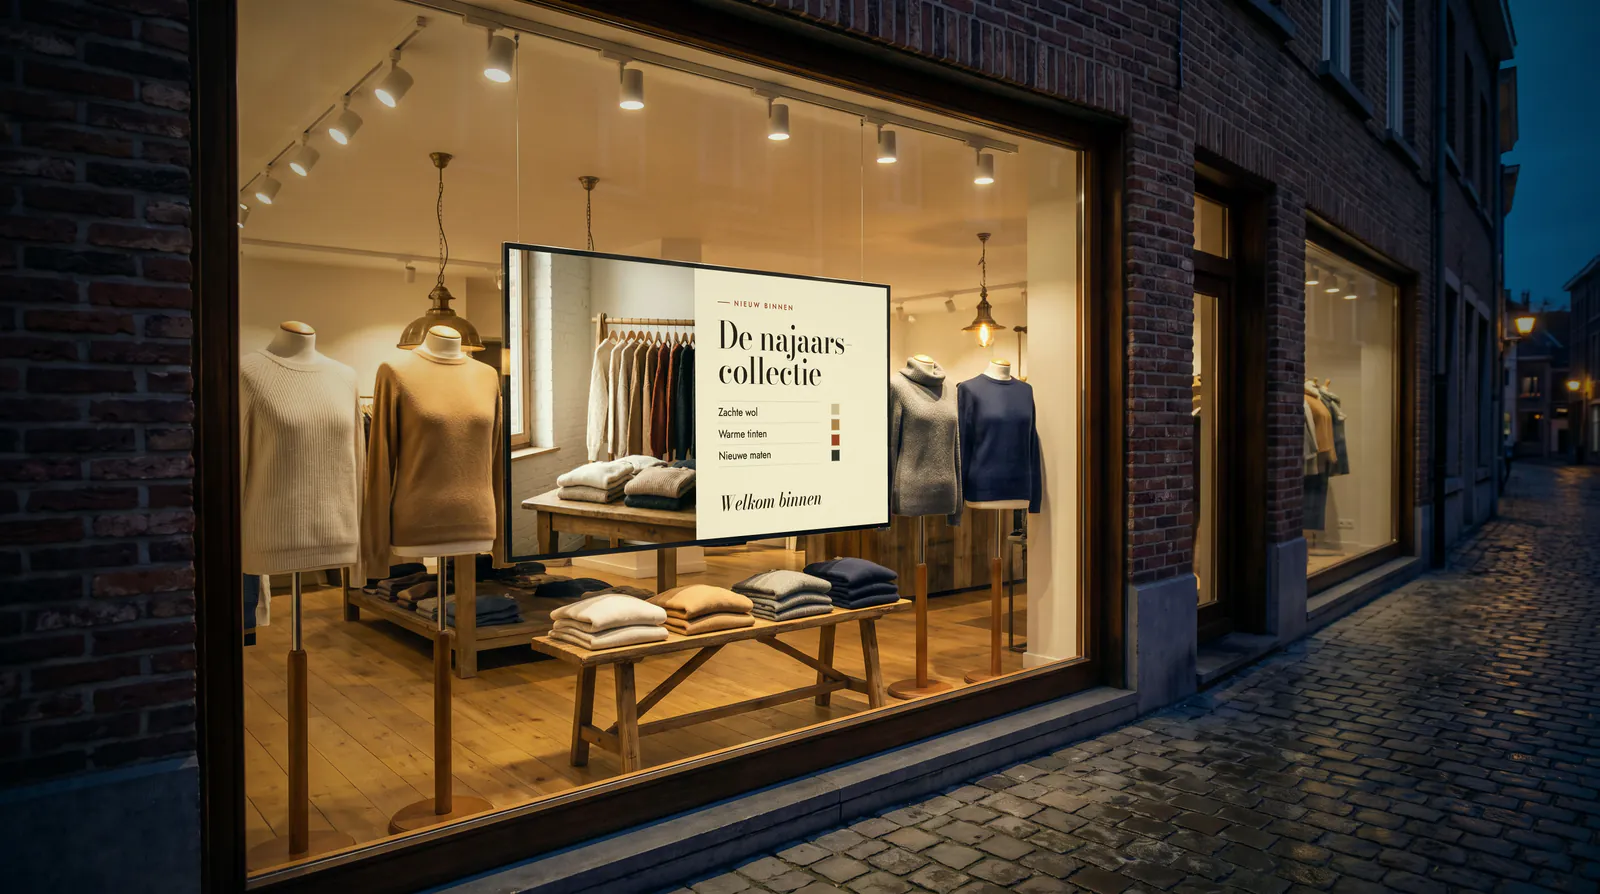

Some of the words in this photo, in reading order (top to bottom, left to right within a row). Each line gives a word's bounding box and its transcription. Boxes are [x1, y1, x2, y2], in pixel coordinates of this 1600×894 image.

[733, 300, 760, 308] NIEUW
[763, 302, 794, 311] BINNEN
[717, 319, 753, 351] De
[760, 324, 853, 361] najaars-
[718, 355, 822, 387] collectie
[718, 407, 743, 417] Zachte
[745, 406, 758, 417] wol
[718, 429, 745, 439] Warme
[747, 429, 767, 438] tinten
[718, 451, 748, 461] Nieuwe
[749, 450, 772, 459] maten
[720, 493, 775, 512] Welkom
[778, 490, 822, 508] binnen
